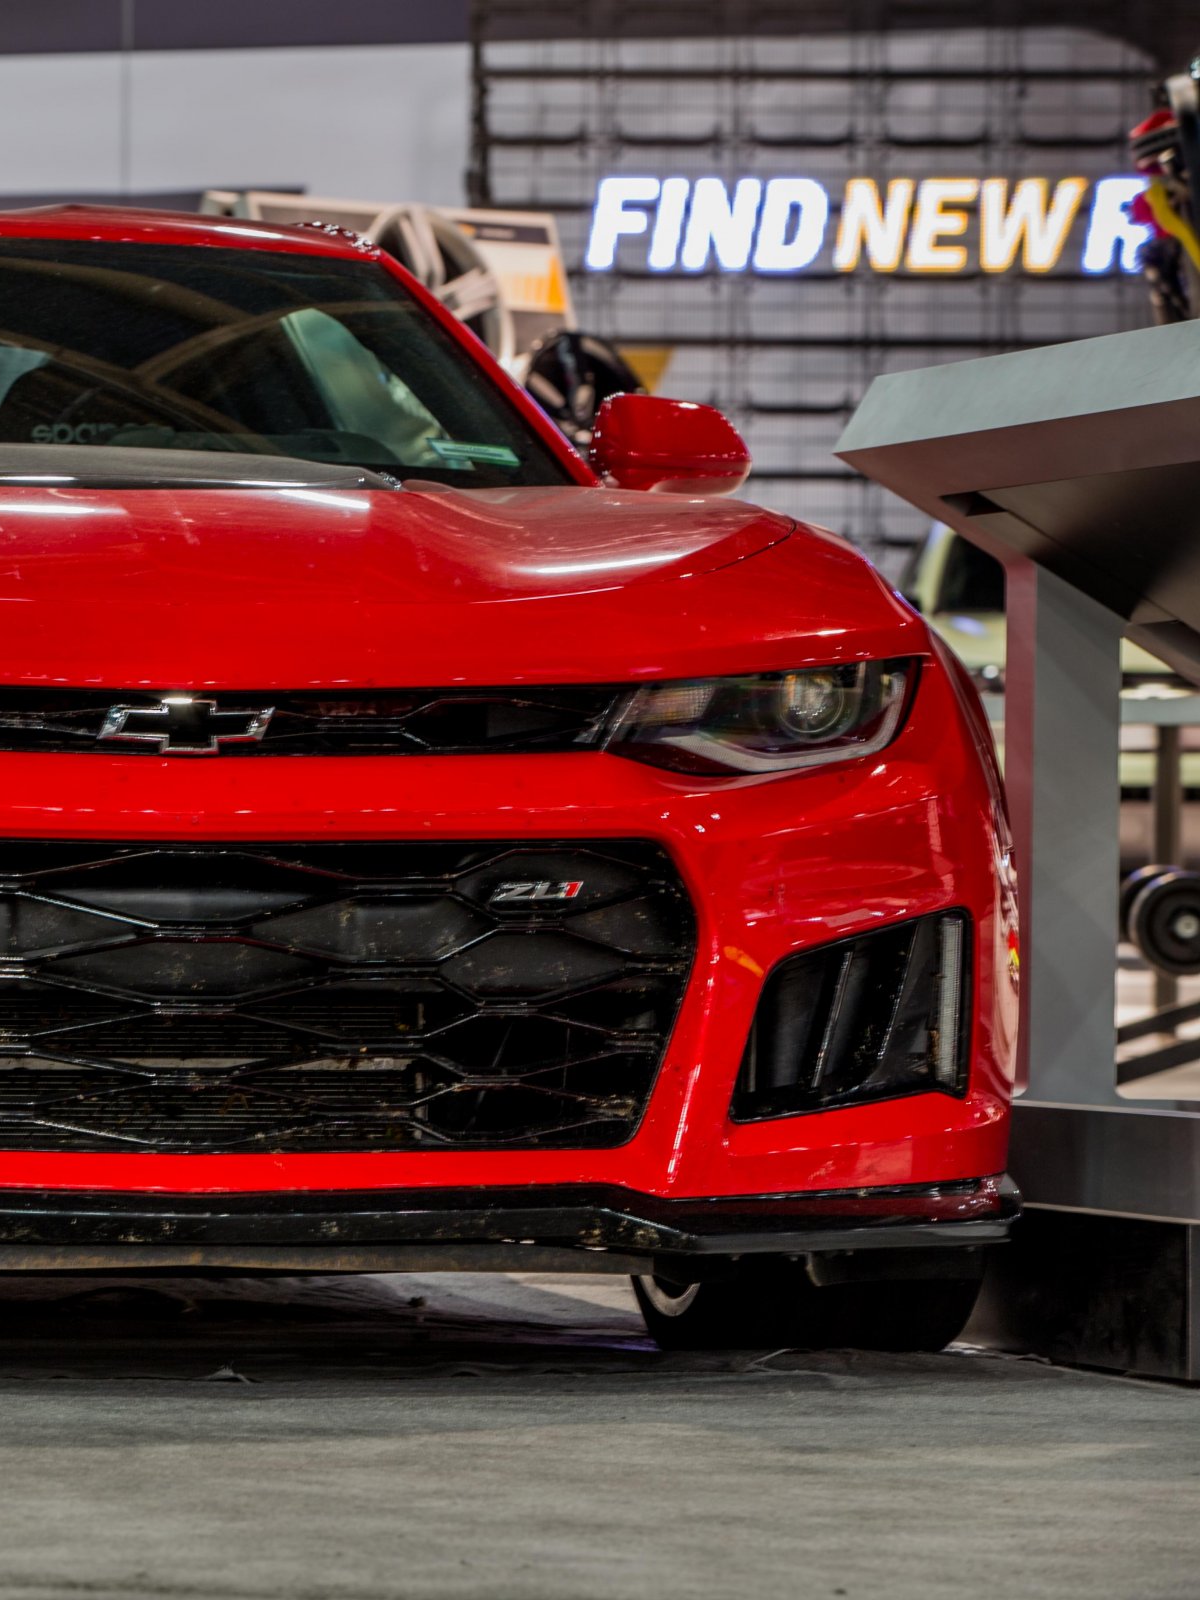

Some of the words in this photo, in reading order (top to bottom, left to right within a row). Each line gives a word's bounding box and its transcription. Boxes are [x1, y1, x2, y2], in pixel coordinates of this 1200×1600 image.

[586, 176, 829, 272] FIND
[833, 176, 1088, 274] NEW
[490, 880, 584, 901] ZL1
